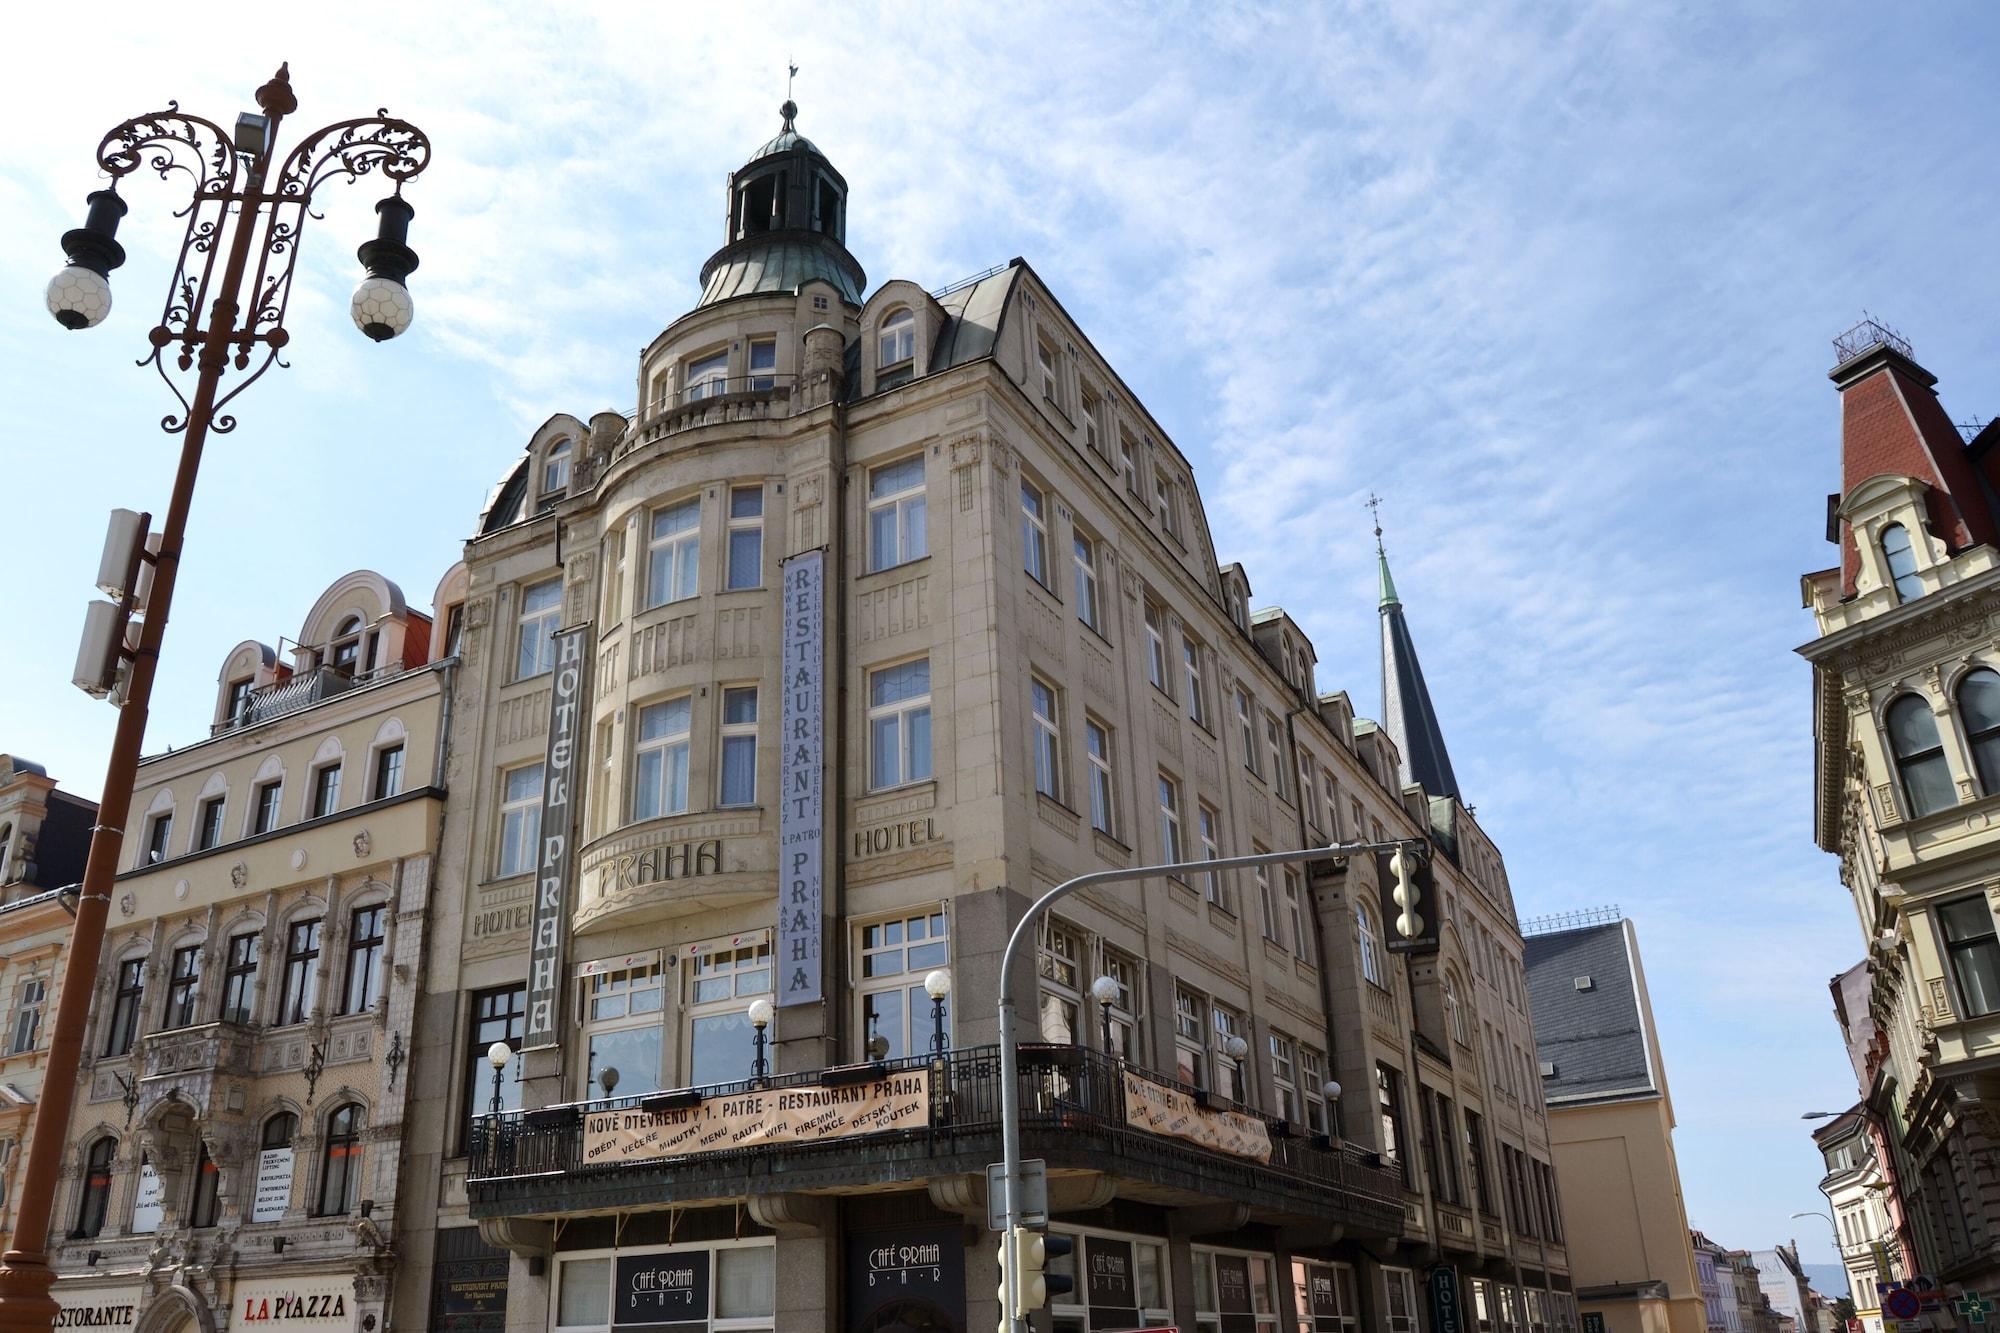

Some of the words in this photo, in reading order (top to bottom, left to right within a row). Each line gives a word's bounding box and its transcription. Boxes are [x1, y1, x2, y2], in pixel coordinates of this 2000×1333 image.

[792, 568, 812, 820] RESTAURANT
[549, 634, 580, 808] HOTEL
[789, 828, 820, 845] PATRO
[855, 816, 944, 857] HOTEL
[599, 840, 722, 897] PRAHA
[528, 835, 565, 1034] PRAHA
[789, 852, 811, 992] PRAHA
[589, 1113, 619, 1134] NOVĚ
[705, 1105, 717, 1121] 1.
[723, 1096, 762, 1118] PATŘE
[779, 1085, 866, 1111] RESTAURANT
[873, 1077, 922, 1099] PRAHA
[852, 1100, 892, 1129] DĚTSKÝ
[875, 1101, 920, 1129] KOUTEK
[732, 1120, 764, 1142] RAUTY
[764, 1122, 787, 1138] WIFI
[795, 1109, 836, 1136] FIREMNÍ
[818, 1116, 845, 1136] AKCE
[588, 1138, 617, 1159] OBĚDY
[659, 1123, 702, 1152] MINUTKY
[700, 1126, 728, 1147] MENU
[869, 1243, 896, 1270] CAFÉ
[899, 1243, 940, 1267] PRAHA
[632, 1267, 656, 1291] CAFÉ
[658, 1268, 693, 1290] PRAHA
[53, 1305, 134, 1328] ISTORANTE
[244, 1298, 269, 1321] LA
[1438, 1275, 1456, 1333] HOTE
